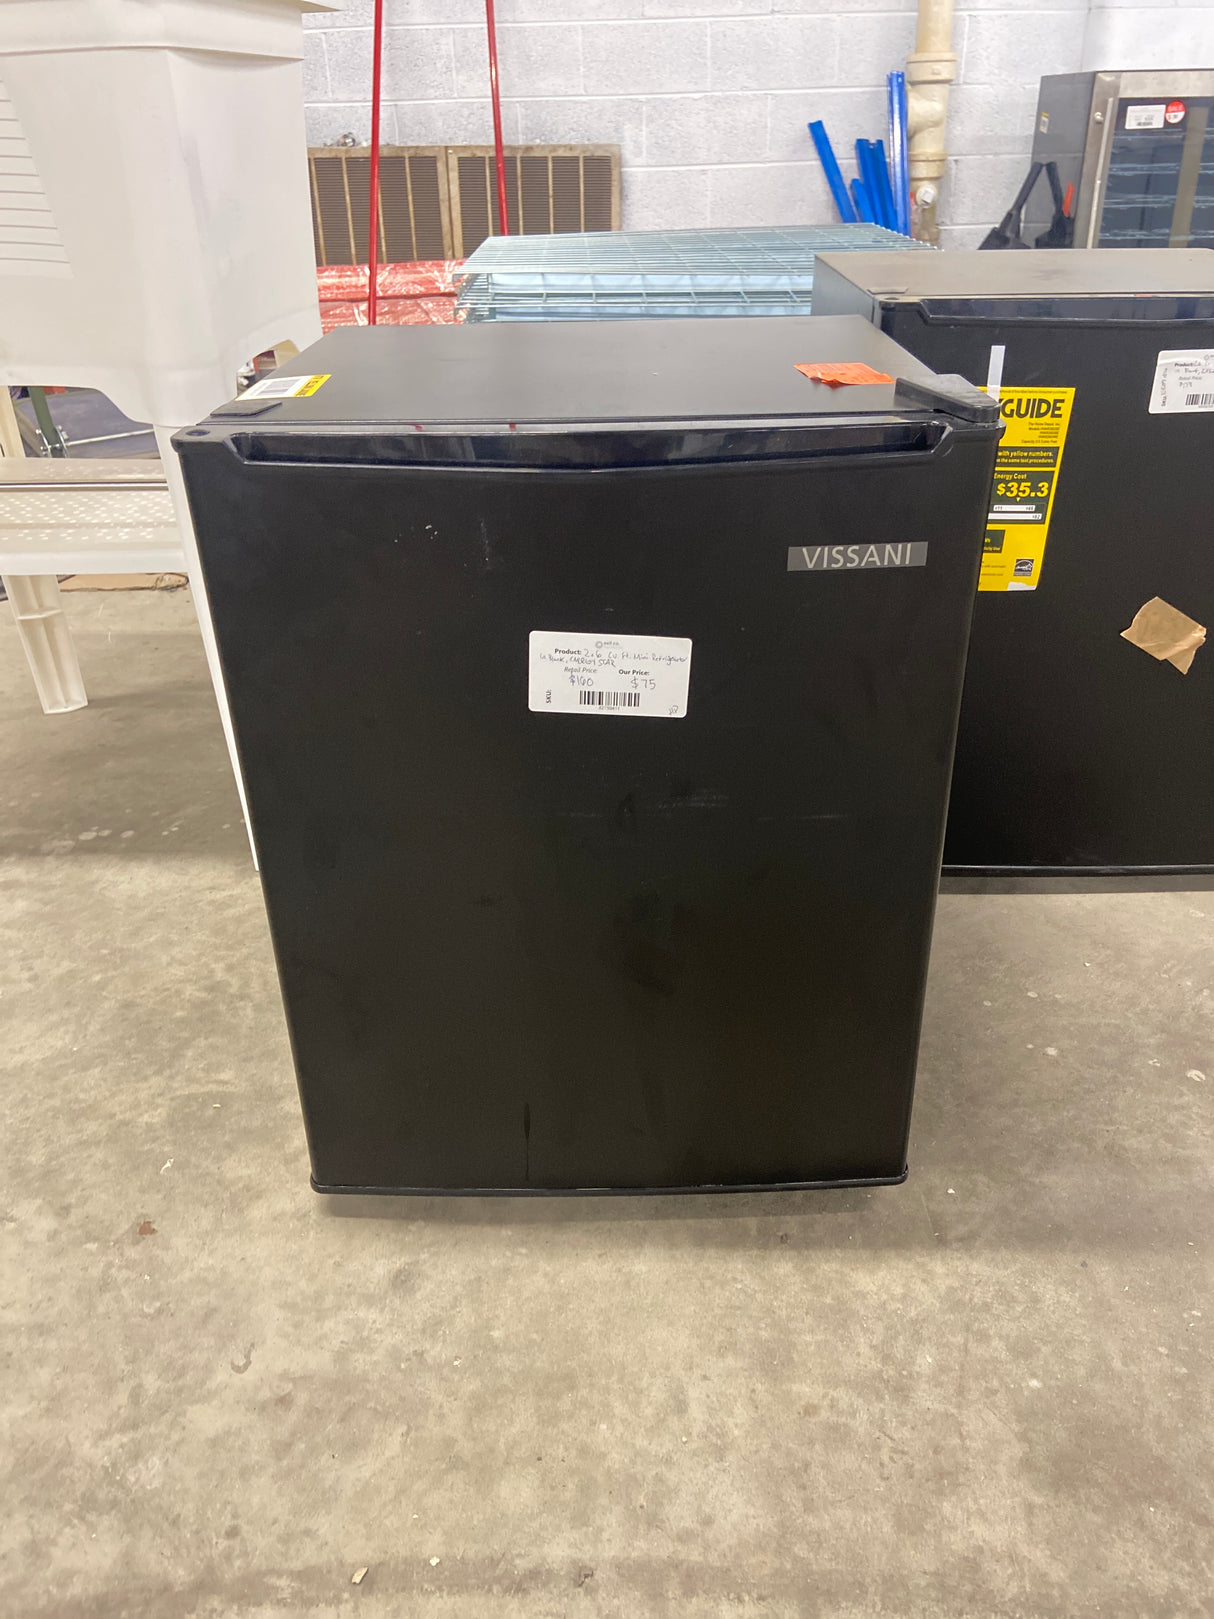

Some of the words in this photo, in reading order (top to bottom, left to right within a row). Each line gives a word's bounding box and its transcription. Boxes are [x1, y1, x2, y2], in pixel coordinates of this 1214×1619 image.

[996, 481, 1049, 497] $35.3
[802, 542, 911, 569] VISSANI
[554, 648, 582, 656] Product:
[630, 676, 656, 690] $75
